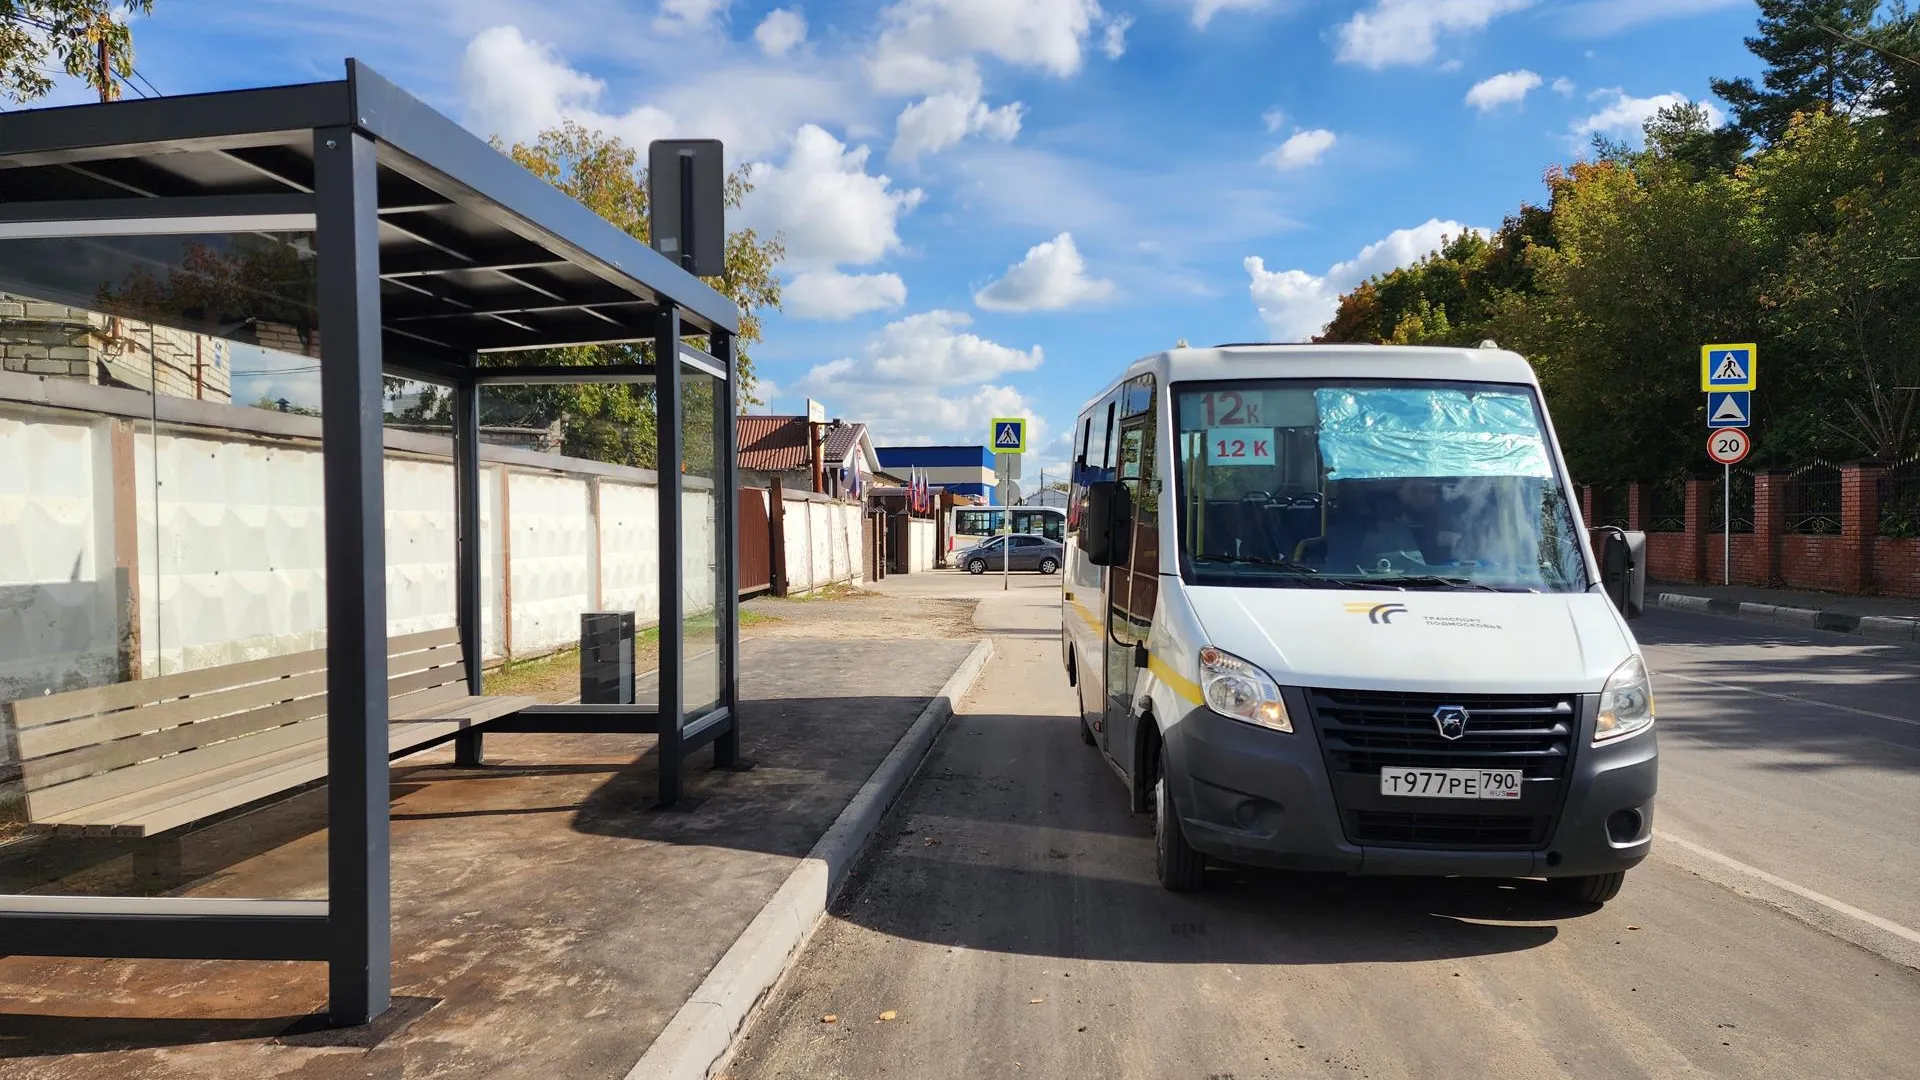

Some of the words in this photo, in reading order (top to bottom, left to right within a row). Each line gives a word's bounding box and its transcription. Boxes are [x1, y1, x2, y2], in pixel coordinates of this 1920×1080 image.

[1217, 440, 1246, 457] 12
[1718, 439, 1740, 453] 20
[1482, 773, 1515, 789] 790
